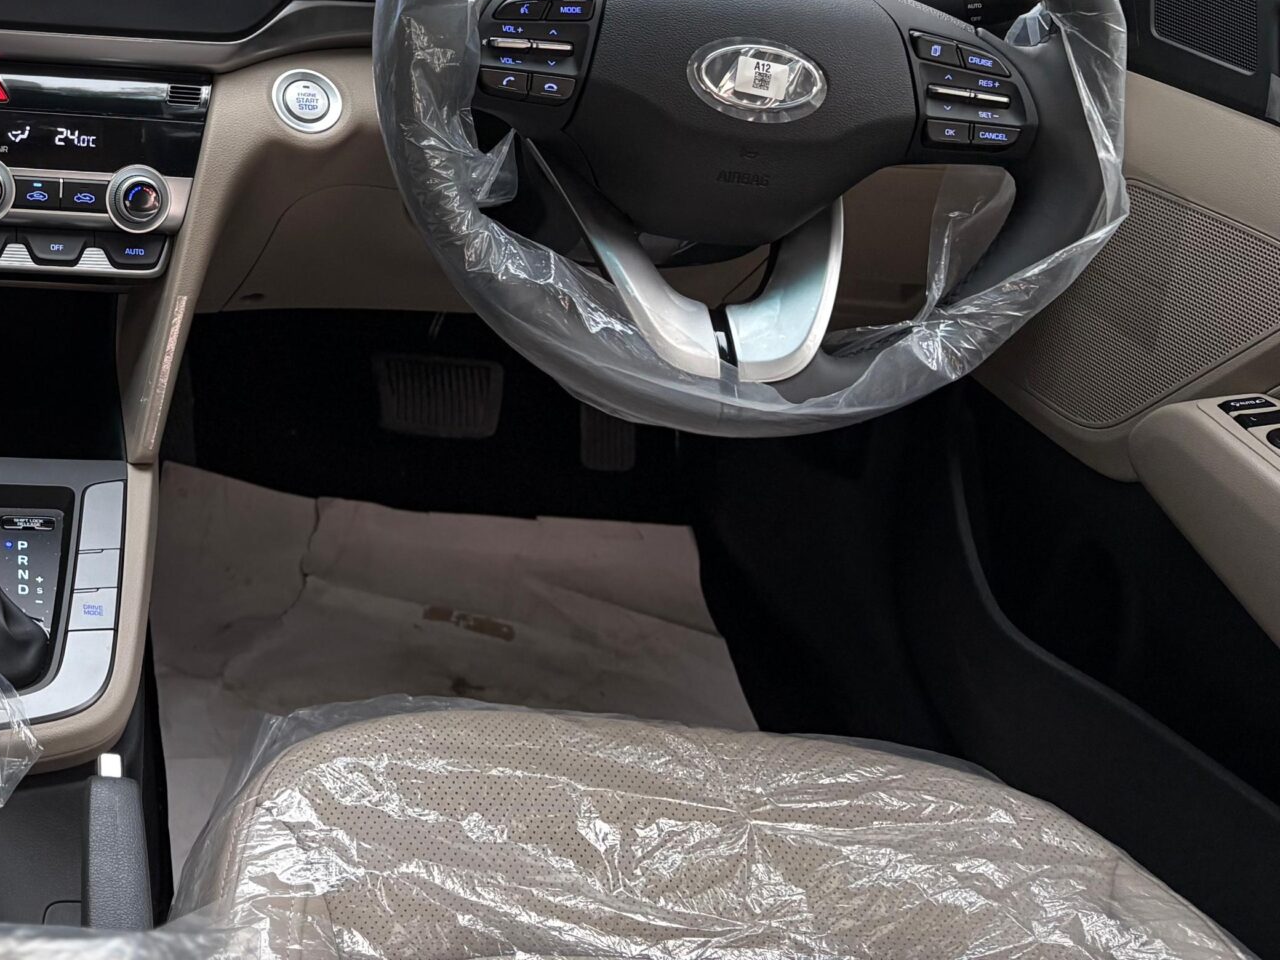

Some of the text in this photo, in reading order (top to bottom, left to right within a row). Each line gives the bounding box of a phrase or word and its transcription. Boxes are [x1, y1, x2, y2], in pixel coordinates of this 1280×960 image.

[560, 6, 583, 14] MODE
[501, 24, 516, 33] VOL
[500, 57, 515, 65] VOL
[968, 56, 993, 68] CRUISE
[754, 61, 772, 74] A12
[978, 79, 993, 88] RES
[298, 103, 319, 111] STOP
[978, 111, 992, 119] SET
[944, 128, 956, 136] OK
[979, 131, 1008, 141] CANCEL
[716, 169, 770, 187] AIRBAG
[50, 244, 65, 252] OFF
[124, 248, 145, 256] AUTO
[17, 540, 29, 551] P
[17, 555, 29, 566] R
[17, 569, 29, 580] N
[17, 584, 30, 595] D
[83, 609, 104, 617] MODE
